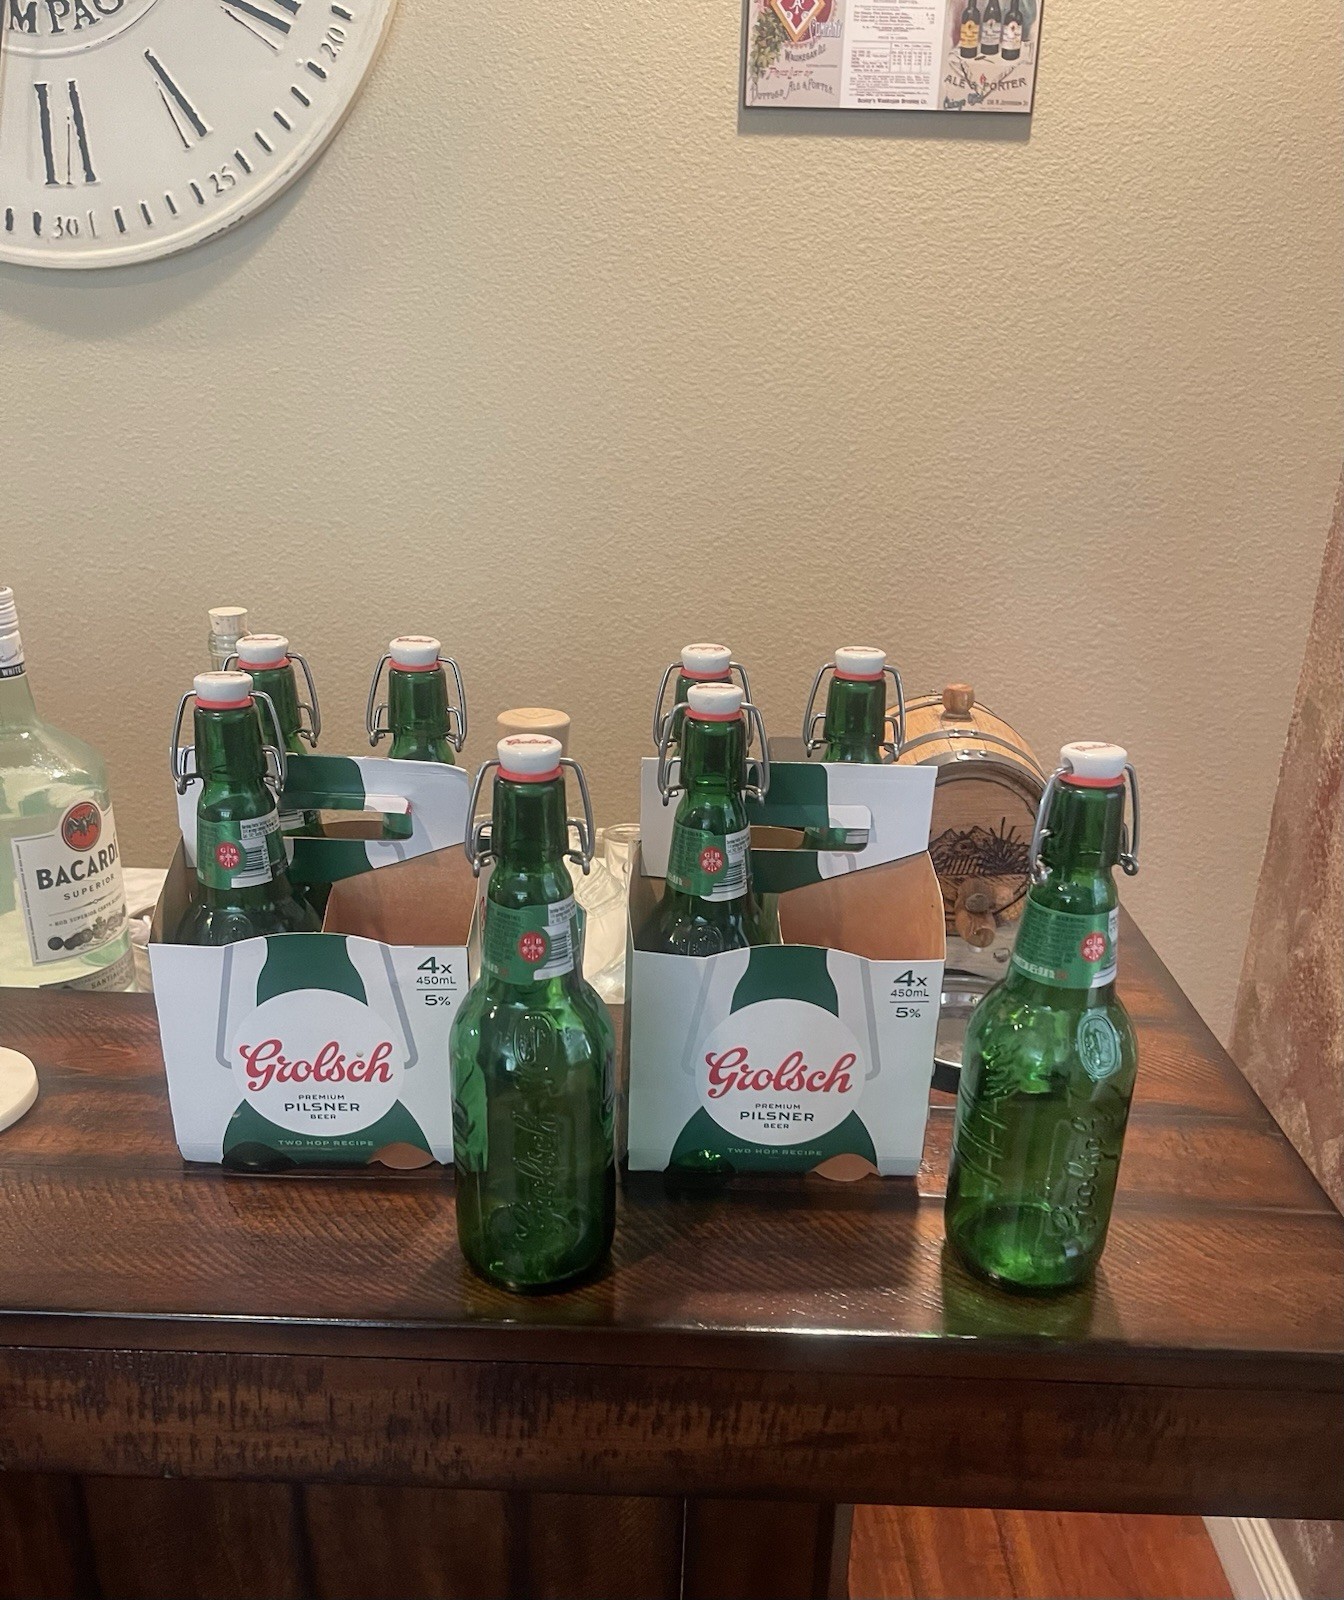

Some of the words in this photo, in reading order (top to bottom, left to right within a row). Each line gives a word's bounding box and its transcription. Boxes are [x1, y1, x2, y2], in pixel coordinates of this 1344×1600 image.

[320, 26, 346, 58] 20
[944, 75, 966, 89] ALE
[983, 78, 1028, 91] PORTER
[210, 166, 236, 193] 25
[54, 216, 79, 237] 30
[2, 664, 22, 677] WHITE
[63, 873, 115, 901] SUPERIOR
[417, 956, 452, 974] 4x
[416, 976, 456, 985] 450mL
[893, 969, 927, 987] 4x
[425, 994, 451, 1006] 5%
[890, 988, 929, 998] 450mL
[895, 1007, 921, 1018] 5%
[239, 1038, 393, 1092] Grolsch
[705, 1046, 857, 1099] Grolsch
[284, 1102, 360, 1112] PILSNER
[740, 1111, 814, 1122] PILSNER
